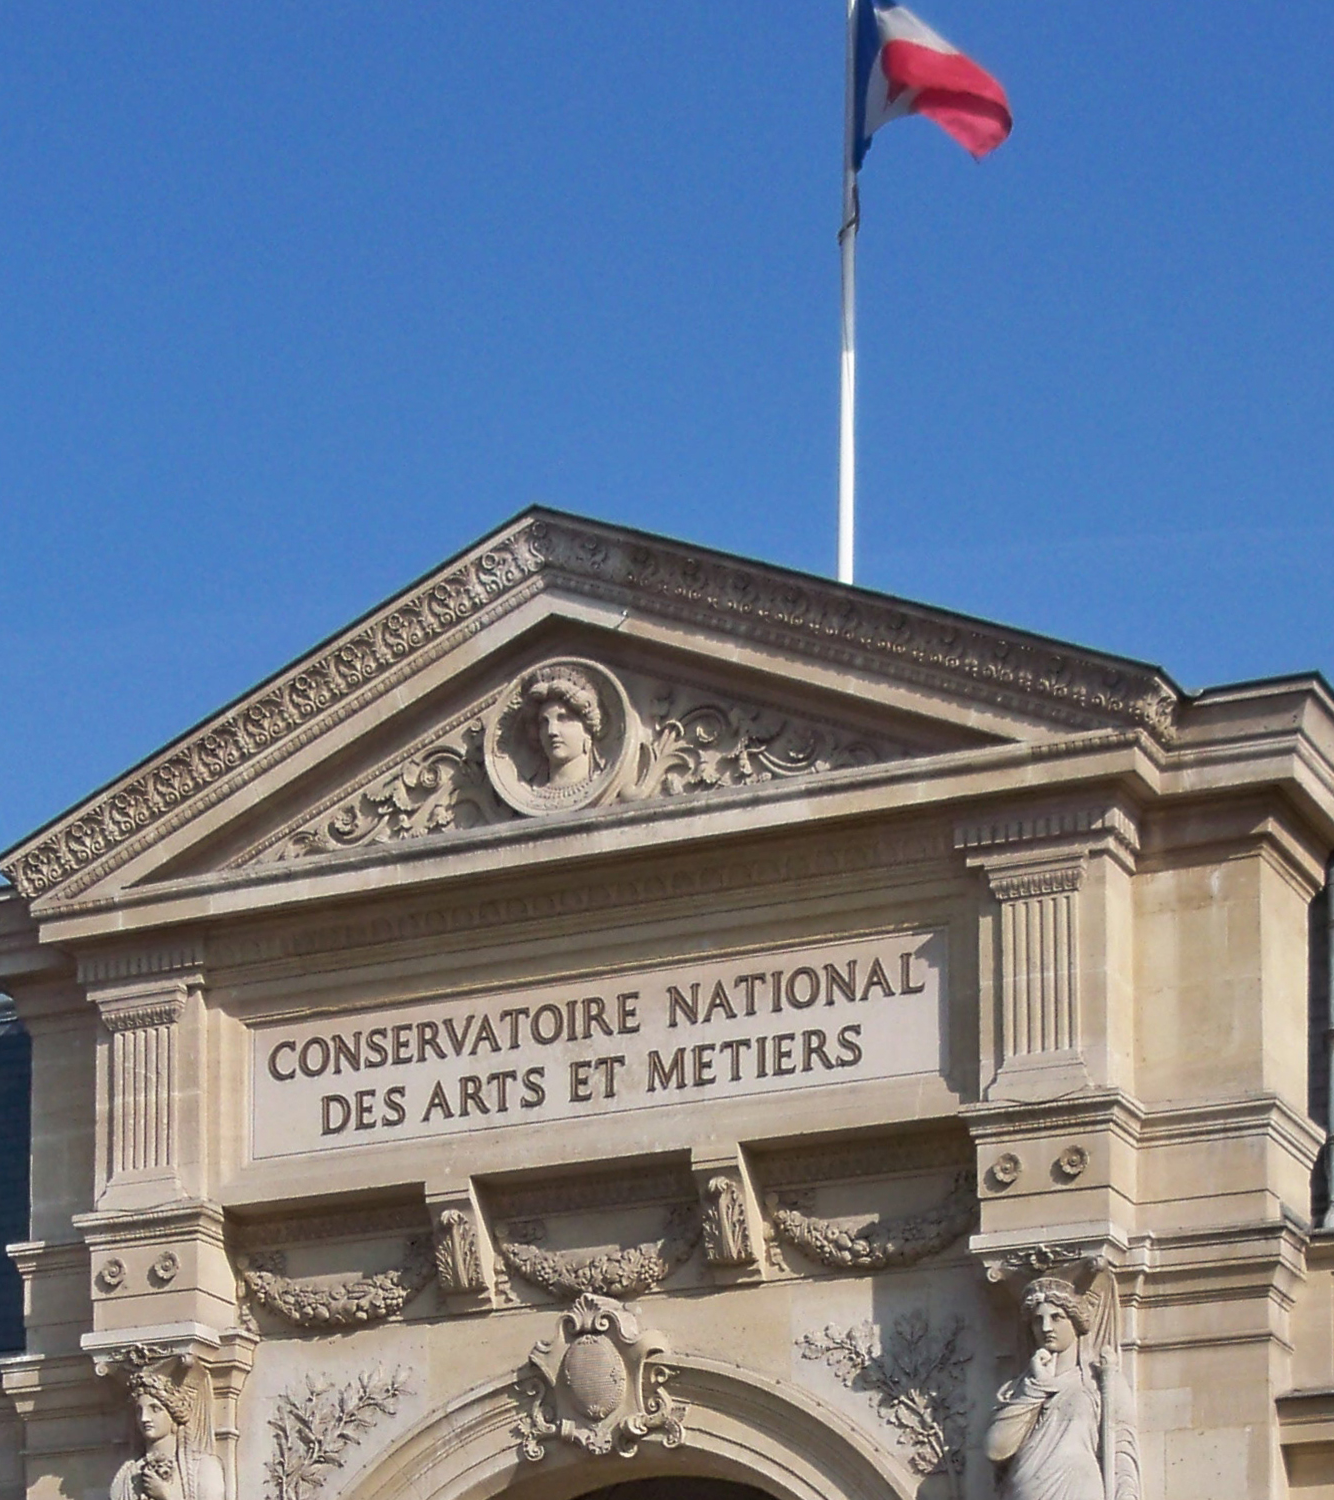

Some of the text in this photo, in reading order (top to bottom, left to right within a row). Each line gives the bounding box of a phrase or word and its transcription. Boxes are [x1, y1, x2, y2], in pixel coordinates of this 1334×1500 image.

[268, 952, 926, 1081] CONSERVATOIRE NATIONAL
[320, 1023, 863, 1137] DES ARTS ET METIERS
